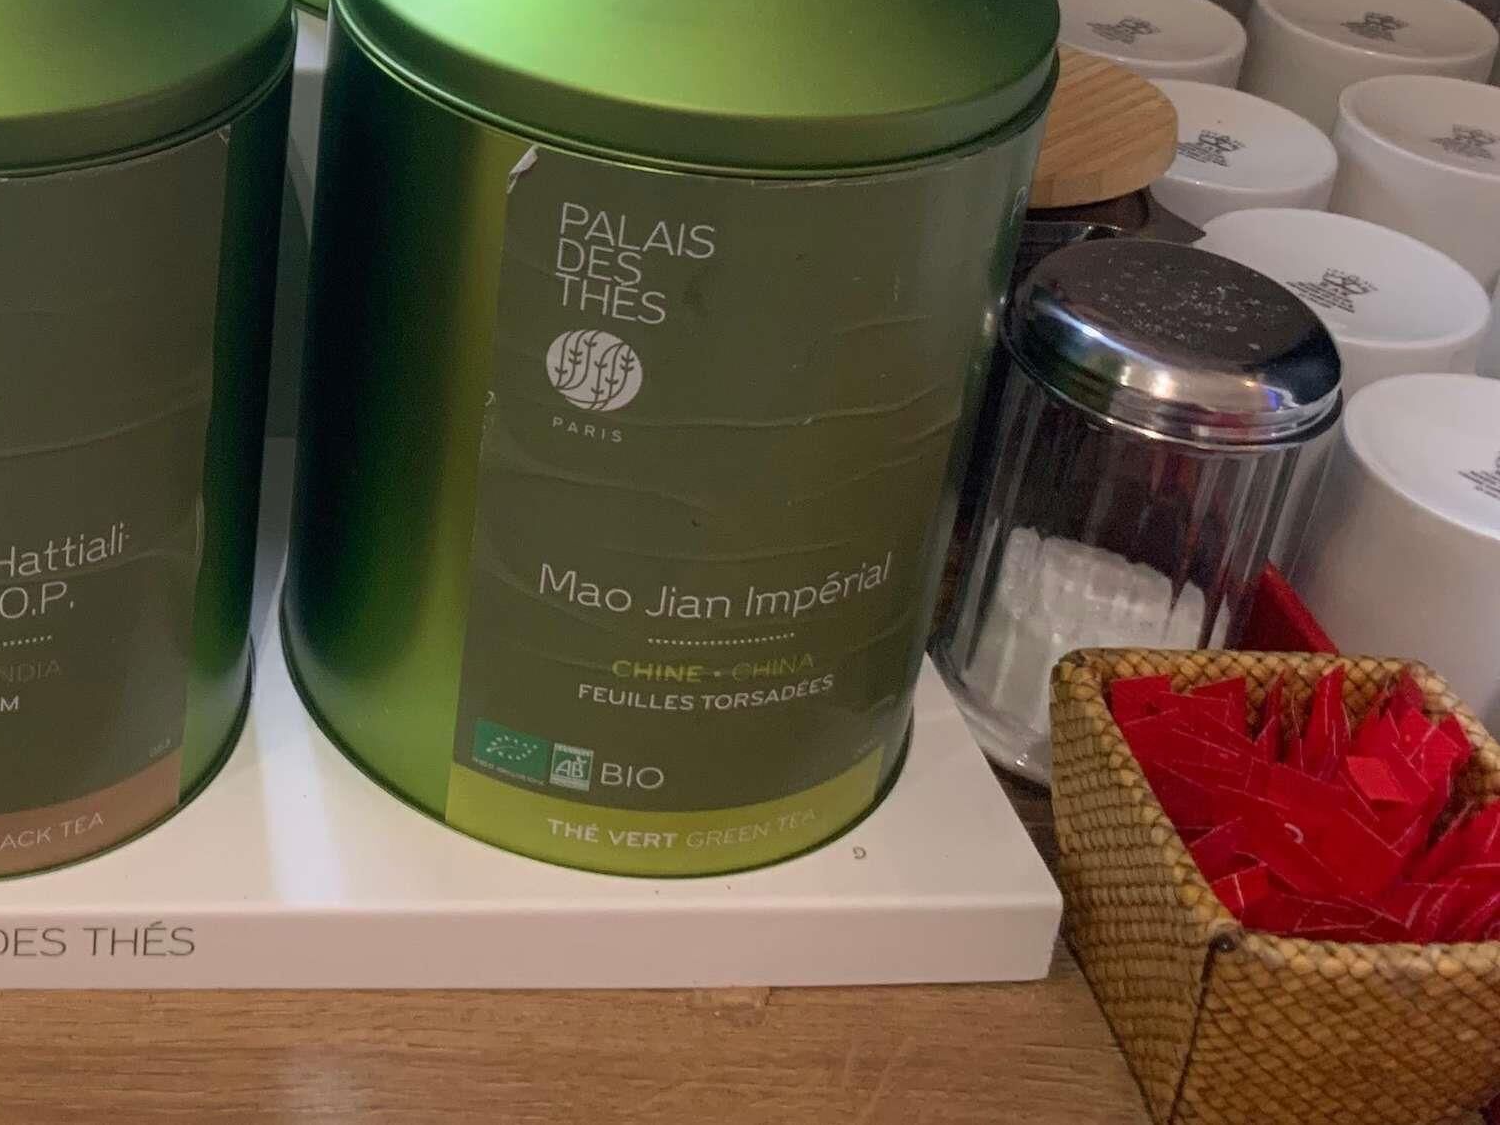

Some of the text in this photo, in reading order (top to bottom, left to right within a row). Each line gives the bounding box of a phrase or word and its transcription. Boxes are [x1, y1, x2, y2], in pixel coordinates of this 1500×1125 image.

[560, 202, 715, 259] PALAIS
[557, 237, 642, 286] DES
[552, 415, 623, 443] PARIS
[539, 551, 892, 618] Mao Jian Impérial
[611, 653, 814, 683] CHINE CHINA
[578, 674, 834, 710] FEUILLES TORSADÉES
[600, 762, 664, 789] BIO
[61, 811, 105, 838] TEA
[547, 809, 816, 849] THÉ VERT GREEN TEA
[83, 920, 196, 958] THÉS
